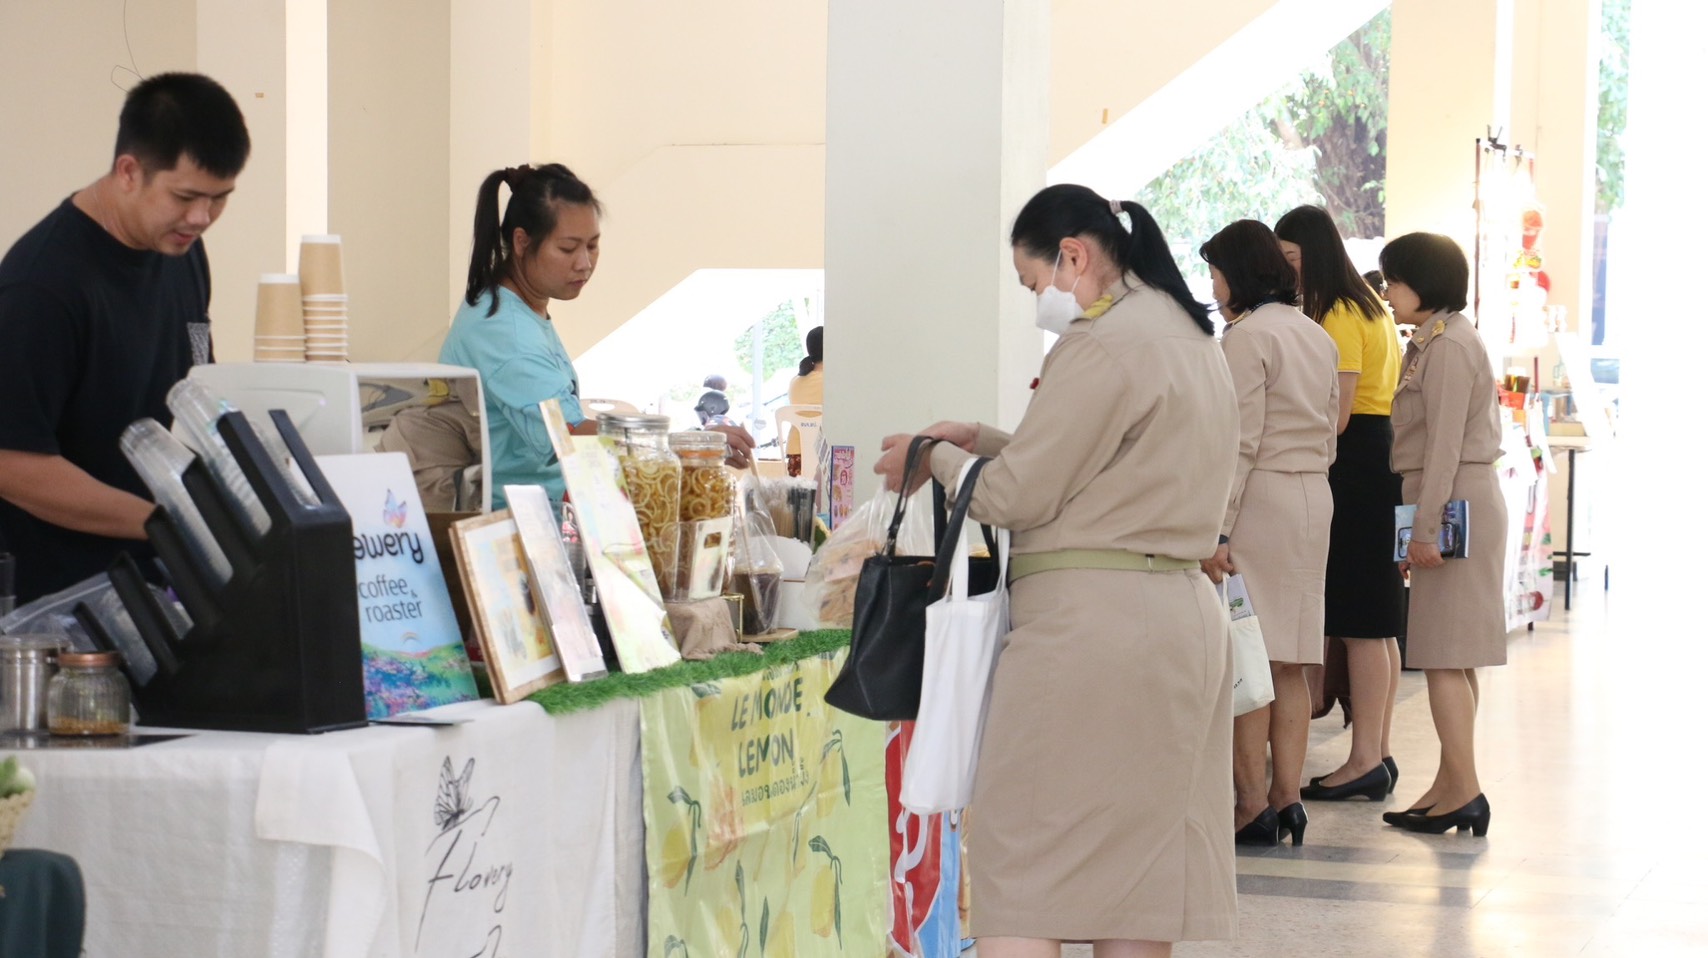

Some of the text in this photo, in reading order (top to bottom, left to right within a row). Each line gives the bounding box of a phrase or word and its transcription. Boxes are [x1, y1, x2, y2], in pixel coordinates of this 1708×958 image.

[353, 532, 424, 564] owery
[358, 574, 409, 599] coffee
[365, 600, 422, 623] roaster
[738, 728, 794, 779] LEMON
